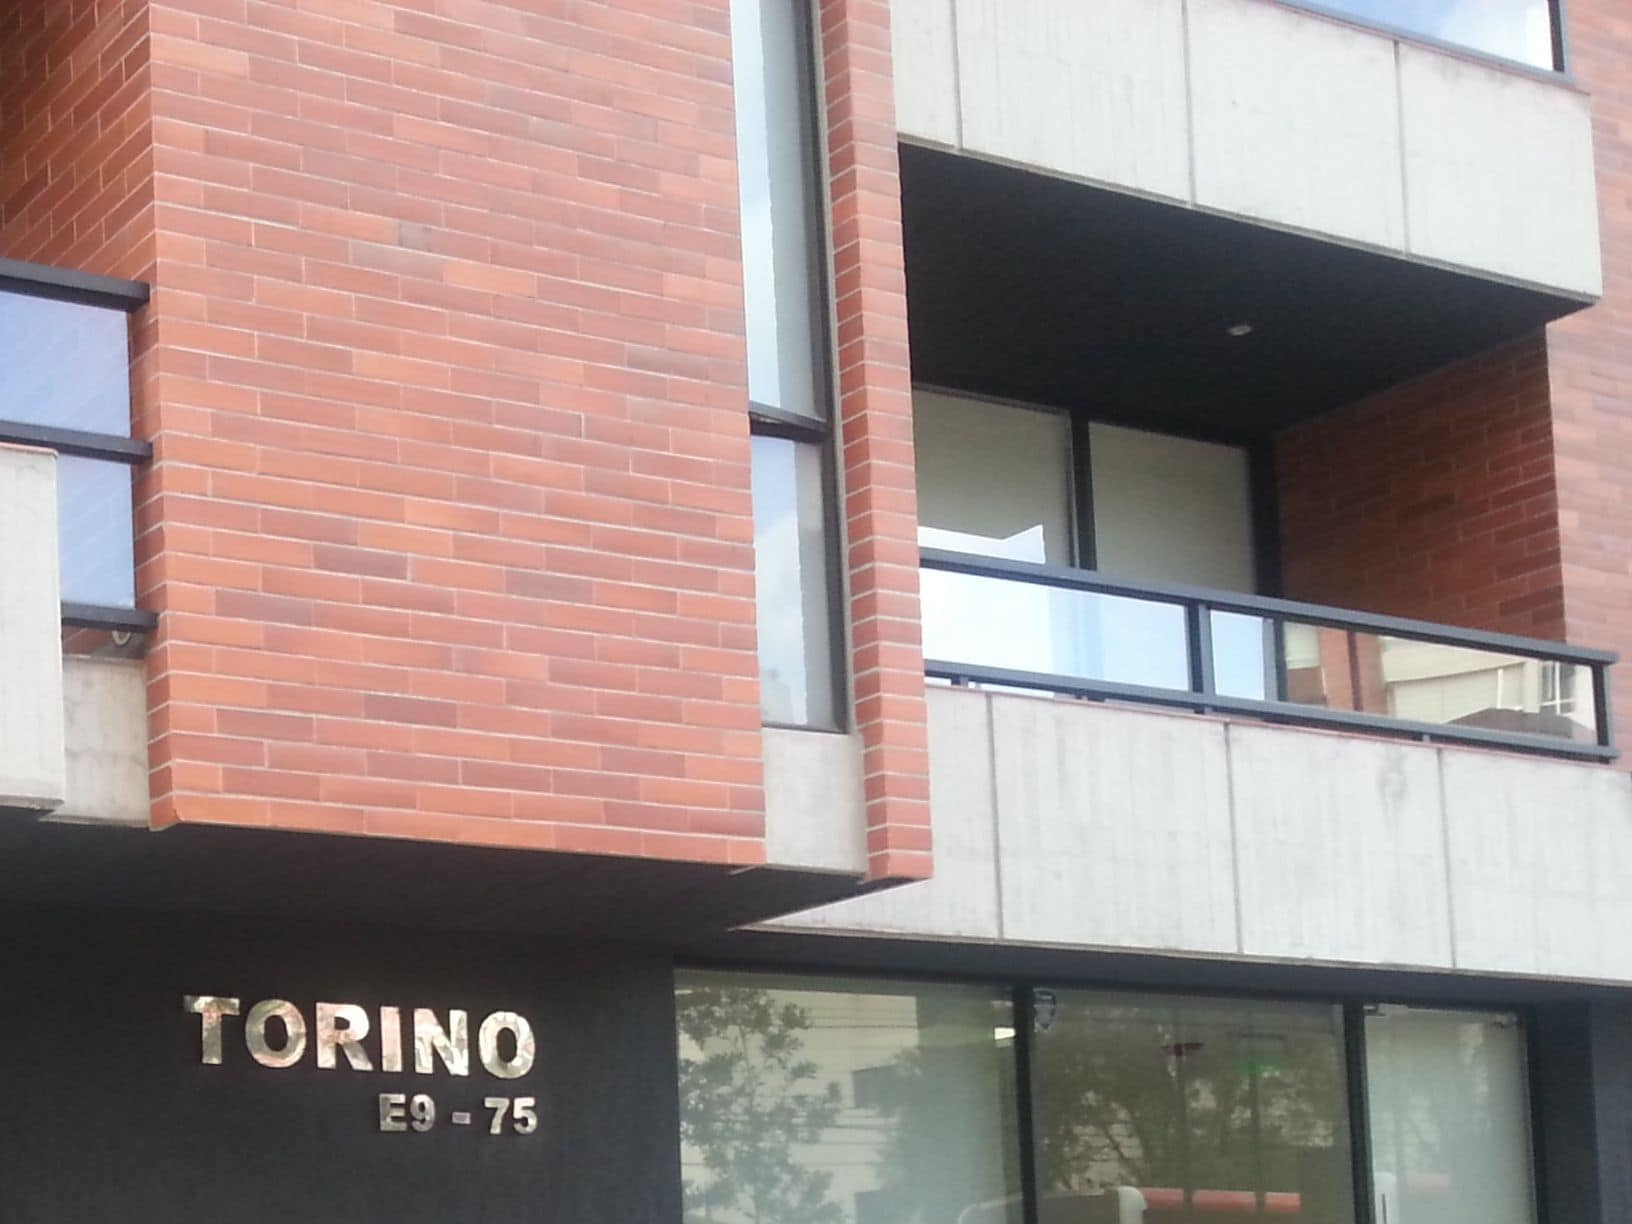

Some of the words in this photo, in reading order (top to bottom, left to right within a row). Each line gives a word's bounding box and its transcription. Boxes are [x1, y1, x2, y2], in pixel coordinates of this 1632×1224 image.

[183, 994, 536, 1079] TORINO
[378, 1093, 436, 1132] E9
[484, 1097, 538, 1135] 75
